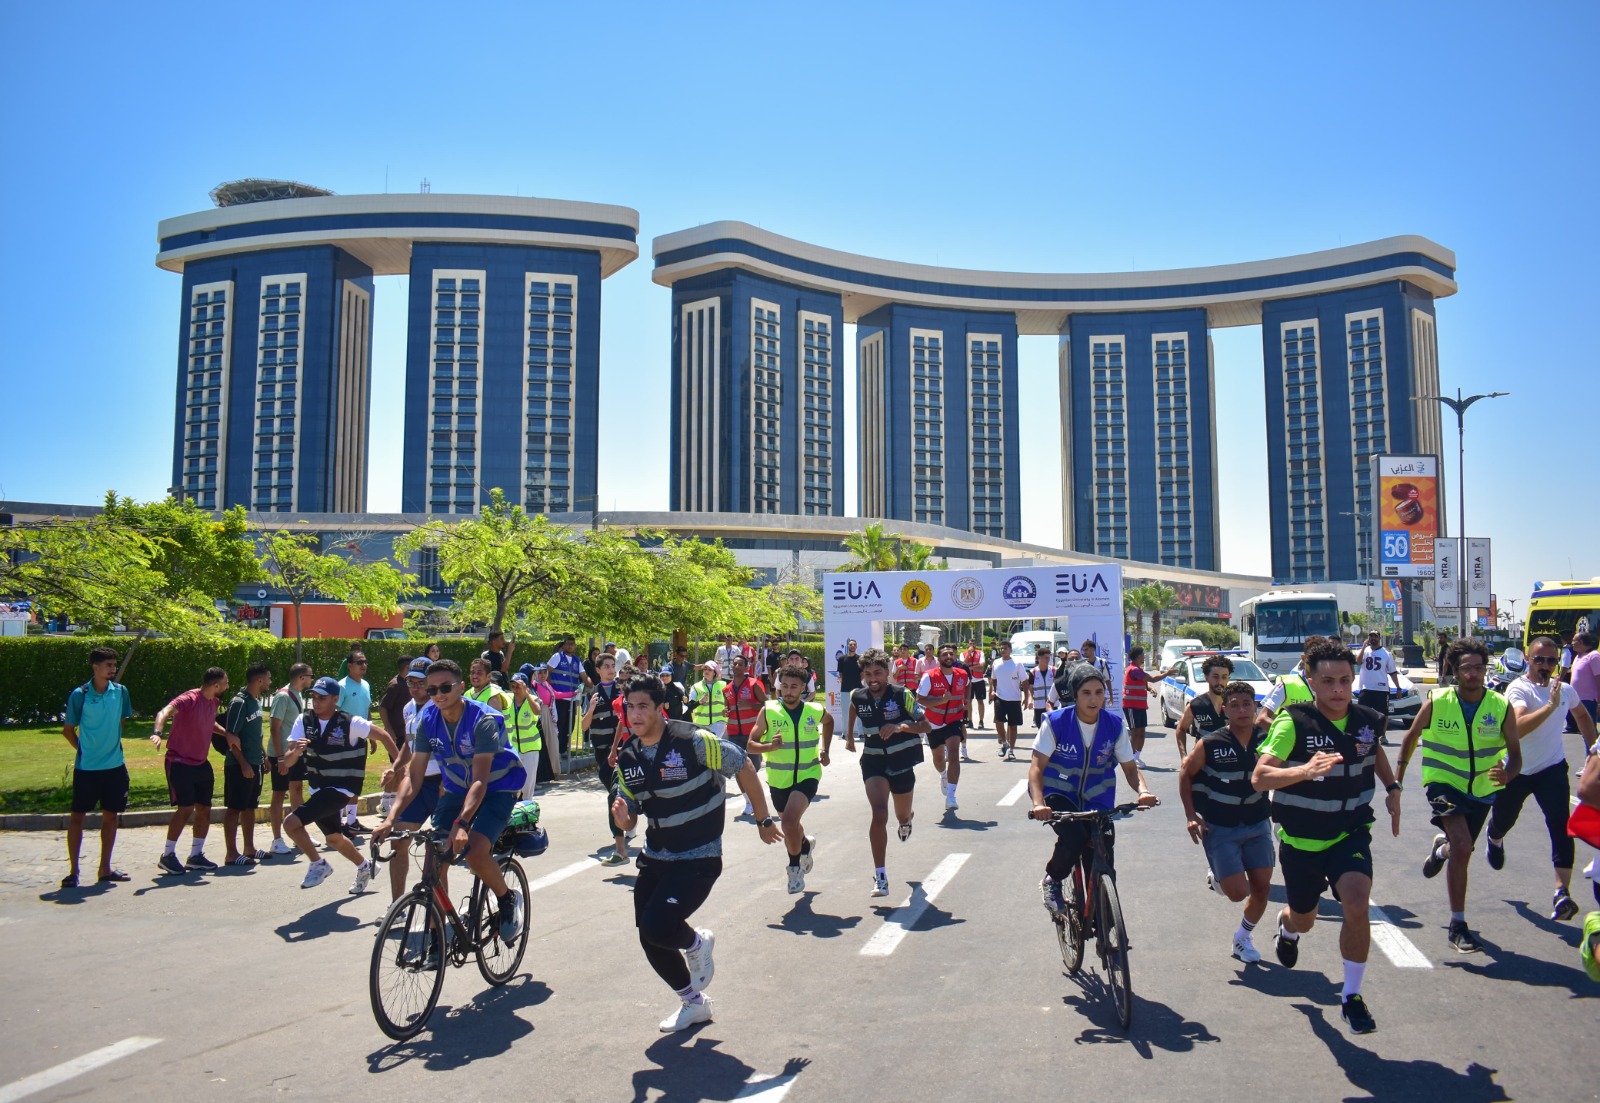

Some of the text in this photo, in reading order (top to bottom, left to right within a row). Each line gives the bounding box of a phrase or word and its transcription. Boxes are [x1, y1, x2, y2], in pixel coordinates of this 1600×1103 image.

[1056, 573, 1108, 593] EUA
[834, 580, 881, 600] EUA
[1366, 656, 1382, 670] 85
[772, 719, 789, 728] EUA
[1438, 718, 1460, 729] EUA
[1055, 743, 1078, 753] EUA
[1306, 735, 1334, 748] EUA
[1213, 748, 1236, 759] EUA
[624, 766, 644, 780] EUA
